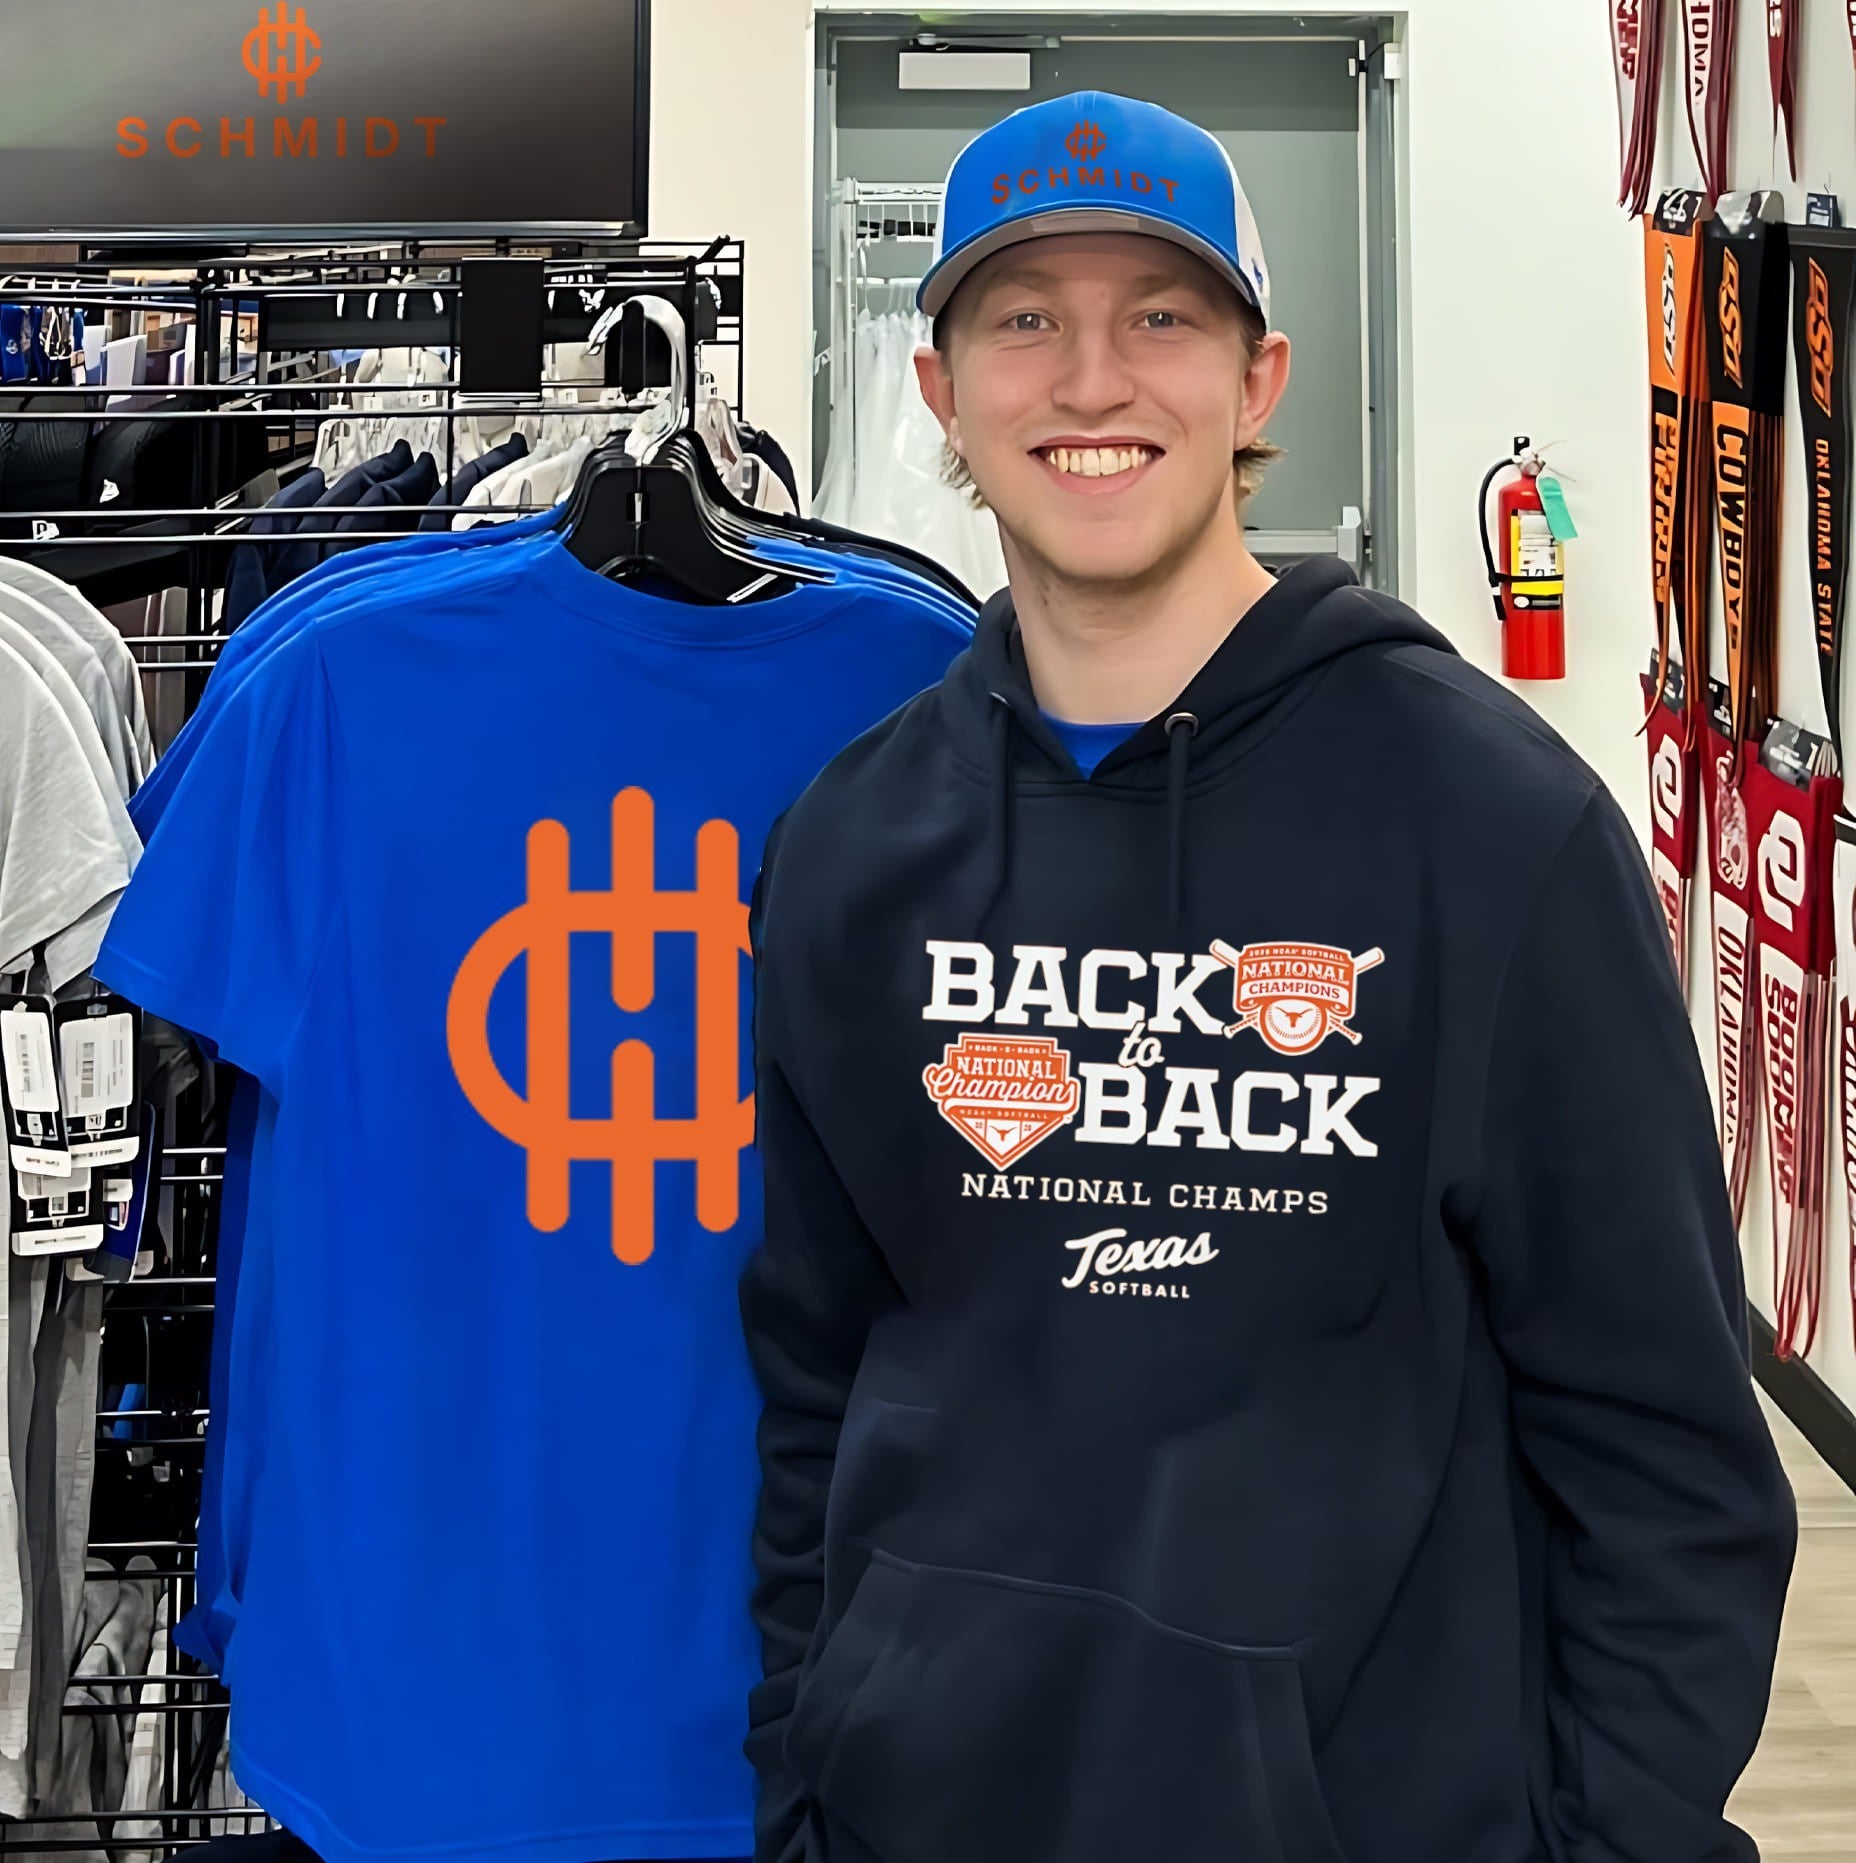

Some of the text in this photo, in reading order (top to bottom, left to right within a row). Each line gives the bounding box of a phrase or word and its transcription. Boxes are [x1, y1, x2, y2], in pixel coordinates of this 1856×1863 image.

[115, 116, 448, 158] SCHMIDT
[992, 167, 1179, 205] SCHMIDT
[1815, 438, 1833, 570] OKLAHOMA
[1241, 961, 1350, 986] NATIONAL
[1301, 949, 1345, 962] SOFTBALL
[922, 940, 1227, 1036] BACK
[1249, 981, 1340, 999] CHAMPIONS
[1117, 1021, 1165, 1068] to
[1718, 925, 1745, 1144] OKLAHOMA
[956, 1056, 1057, 1080] NATIONAL
[997, 1110, 1048, 1119] SOFTBALL
[1075, 1062, 1381, 1157] BACK
[961, 1173, 1329, 1214] NATIONAL CHAMPS
[1061, 1228, 1220, 1288] Texas
[1089, 1280, 1190, 1299] SOFTBALL
